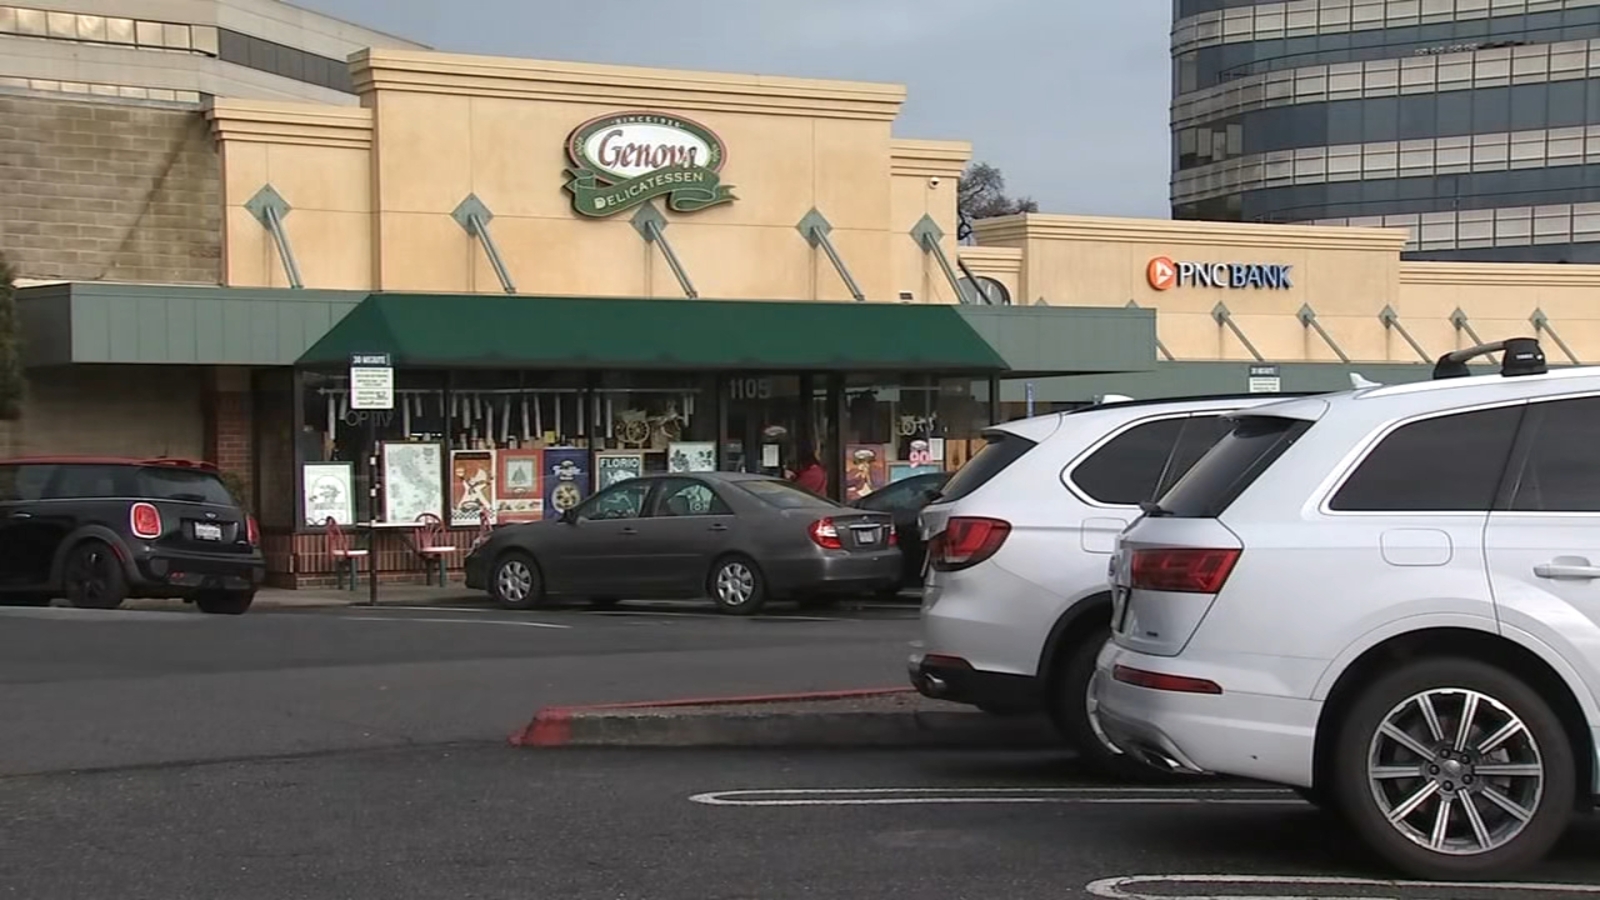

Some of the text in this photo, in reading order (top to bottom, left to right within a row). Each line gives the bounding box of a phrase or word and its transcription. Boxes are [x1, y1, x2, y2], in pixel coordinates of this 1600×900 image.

[597, 129, 698, 168] Genova
[593, 171, 704, 210] DELICATESSEN
[730, 378, 772, 399] 1105
[600, 458, 639, 468] FLORIO
